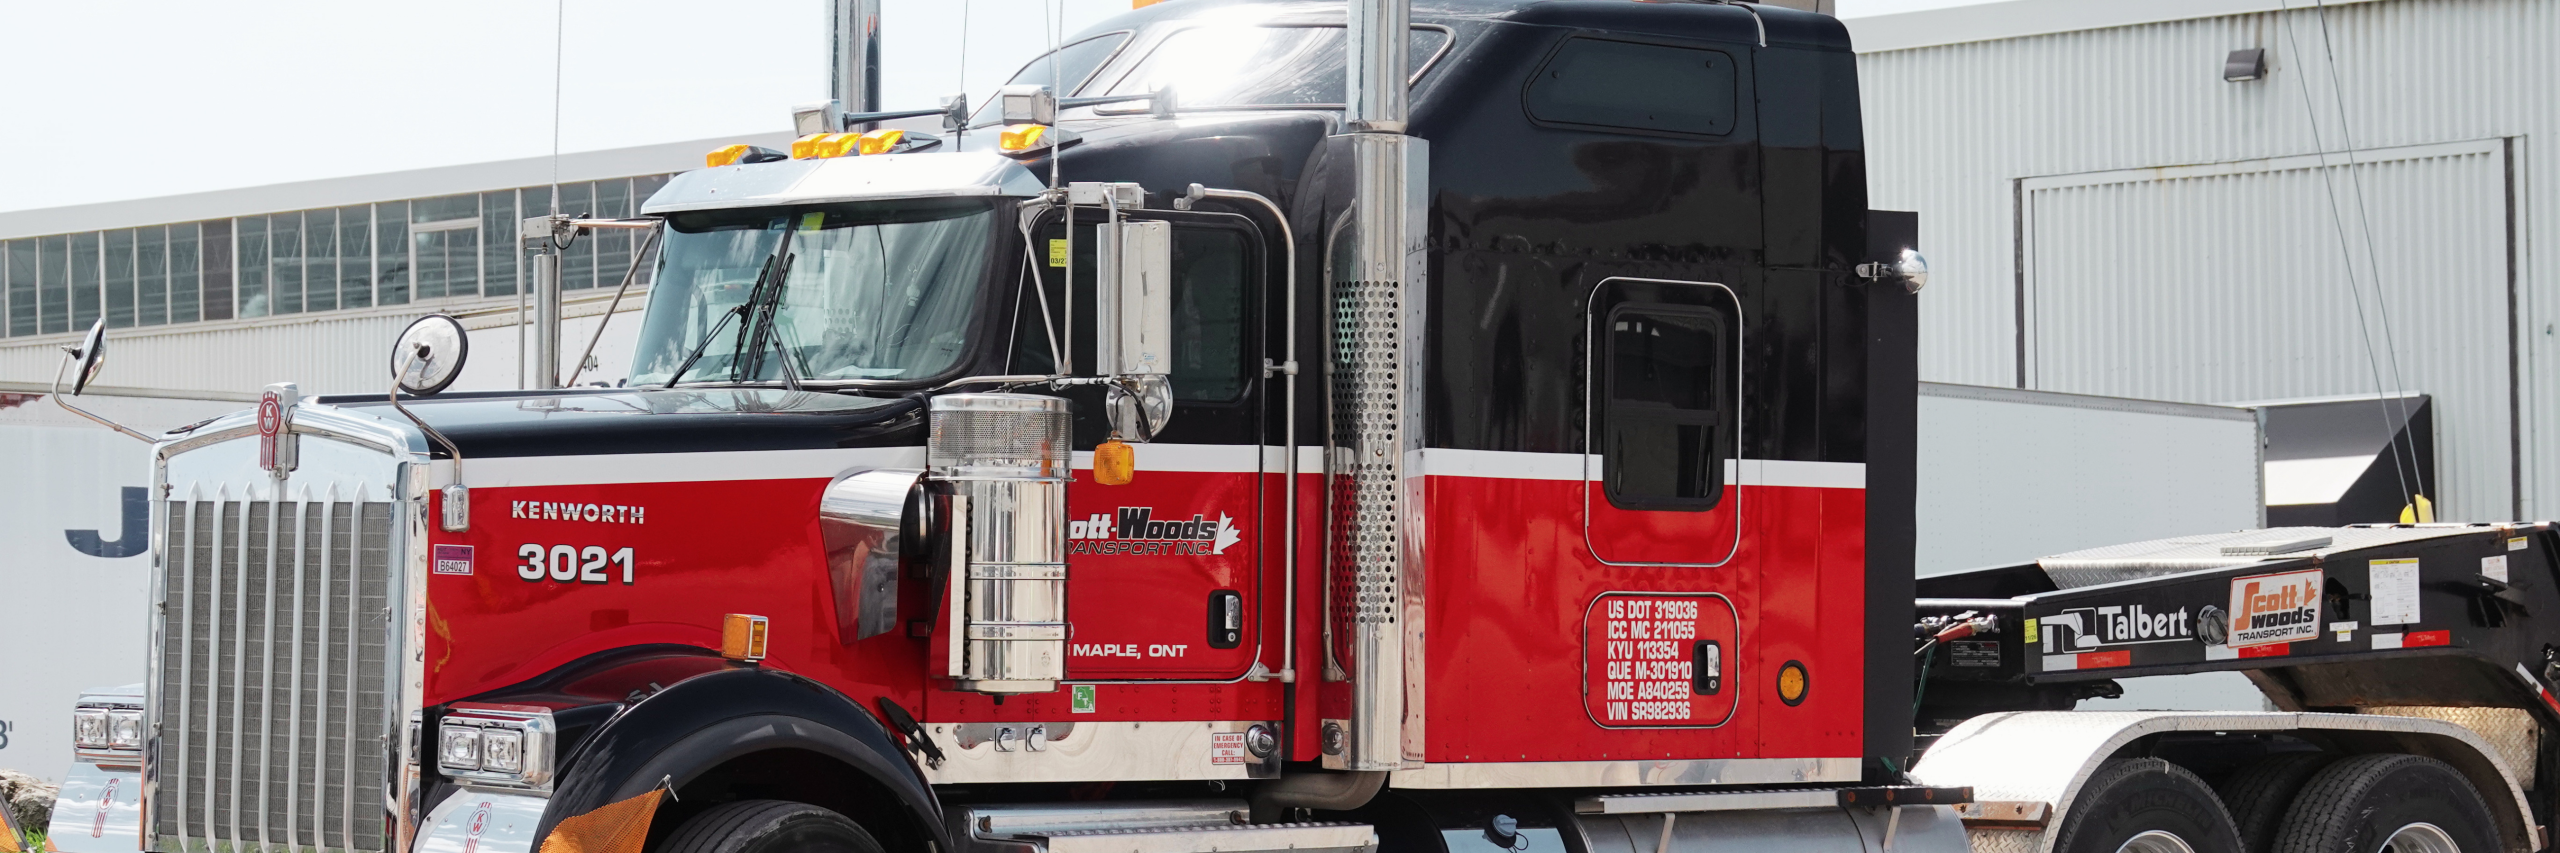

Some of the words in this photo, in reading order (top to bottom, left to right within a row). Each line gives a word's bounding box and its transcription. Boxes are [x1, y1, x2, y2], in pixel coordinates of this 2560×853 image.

[512, 500, 645, 524] KENWORTH
[1068, 541, 1172, 555] ANSPORT
[1175, 541, 1212, 555] INC.
[440, 560, 467, 572] B64027
[518, 543, 635, 585] 3021
[1608, 600, 1624, 619] US
[1628, 600, 1652, 619] DOT
[1655, 601, 1698, 619] 319036
[1607, 620, 1627, 639] ICC
[1631, 621, 1650, 639] MC
[1654, 621, 1695, 639] 211055
[2098, 604, 2188, 640] Talbert
[2238, 627, 2294, 641] TRANSPORT
[2296, 625, 2313, 635] INC.
[1073, 644, 1141, 659] MAPLE,
[1148, 644, 1188, 657] ONT
[1607, 641, 1633, 659] KYU
[1637, 641, 1679, 659] 113354
[1607, 661, 1632, 680] QUE
[1635, 661, 1692, 680] M-301910
[1607, 681, 1634, 700] MOE
[1637, 681, 1690, 700] A840259
[1607, 702, 1628, 720] VIN
[1631, 701, 1690, 720] SR982936
